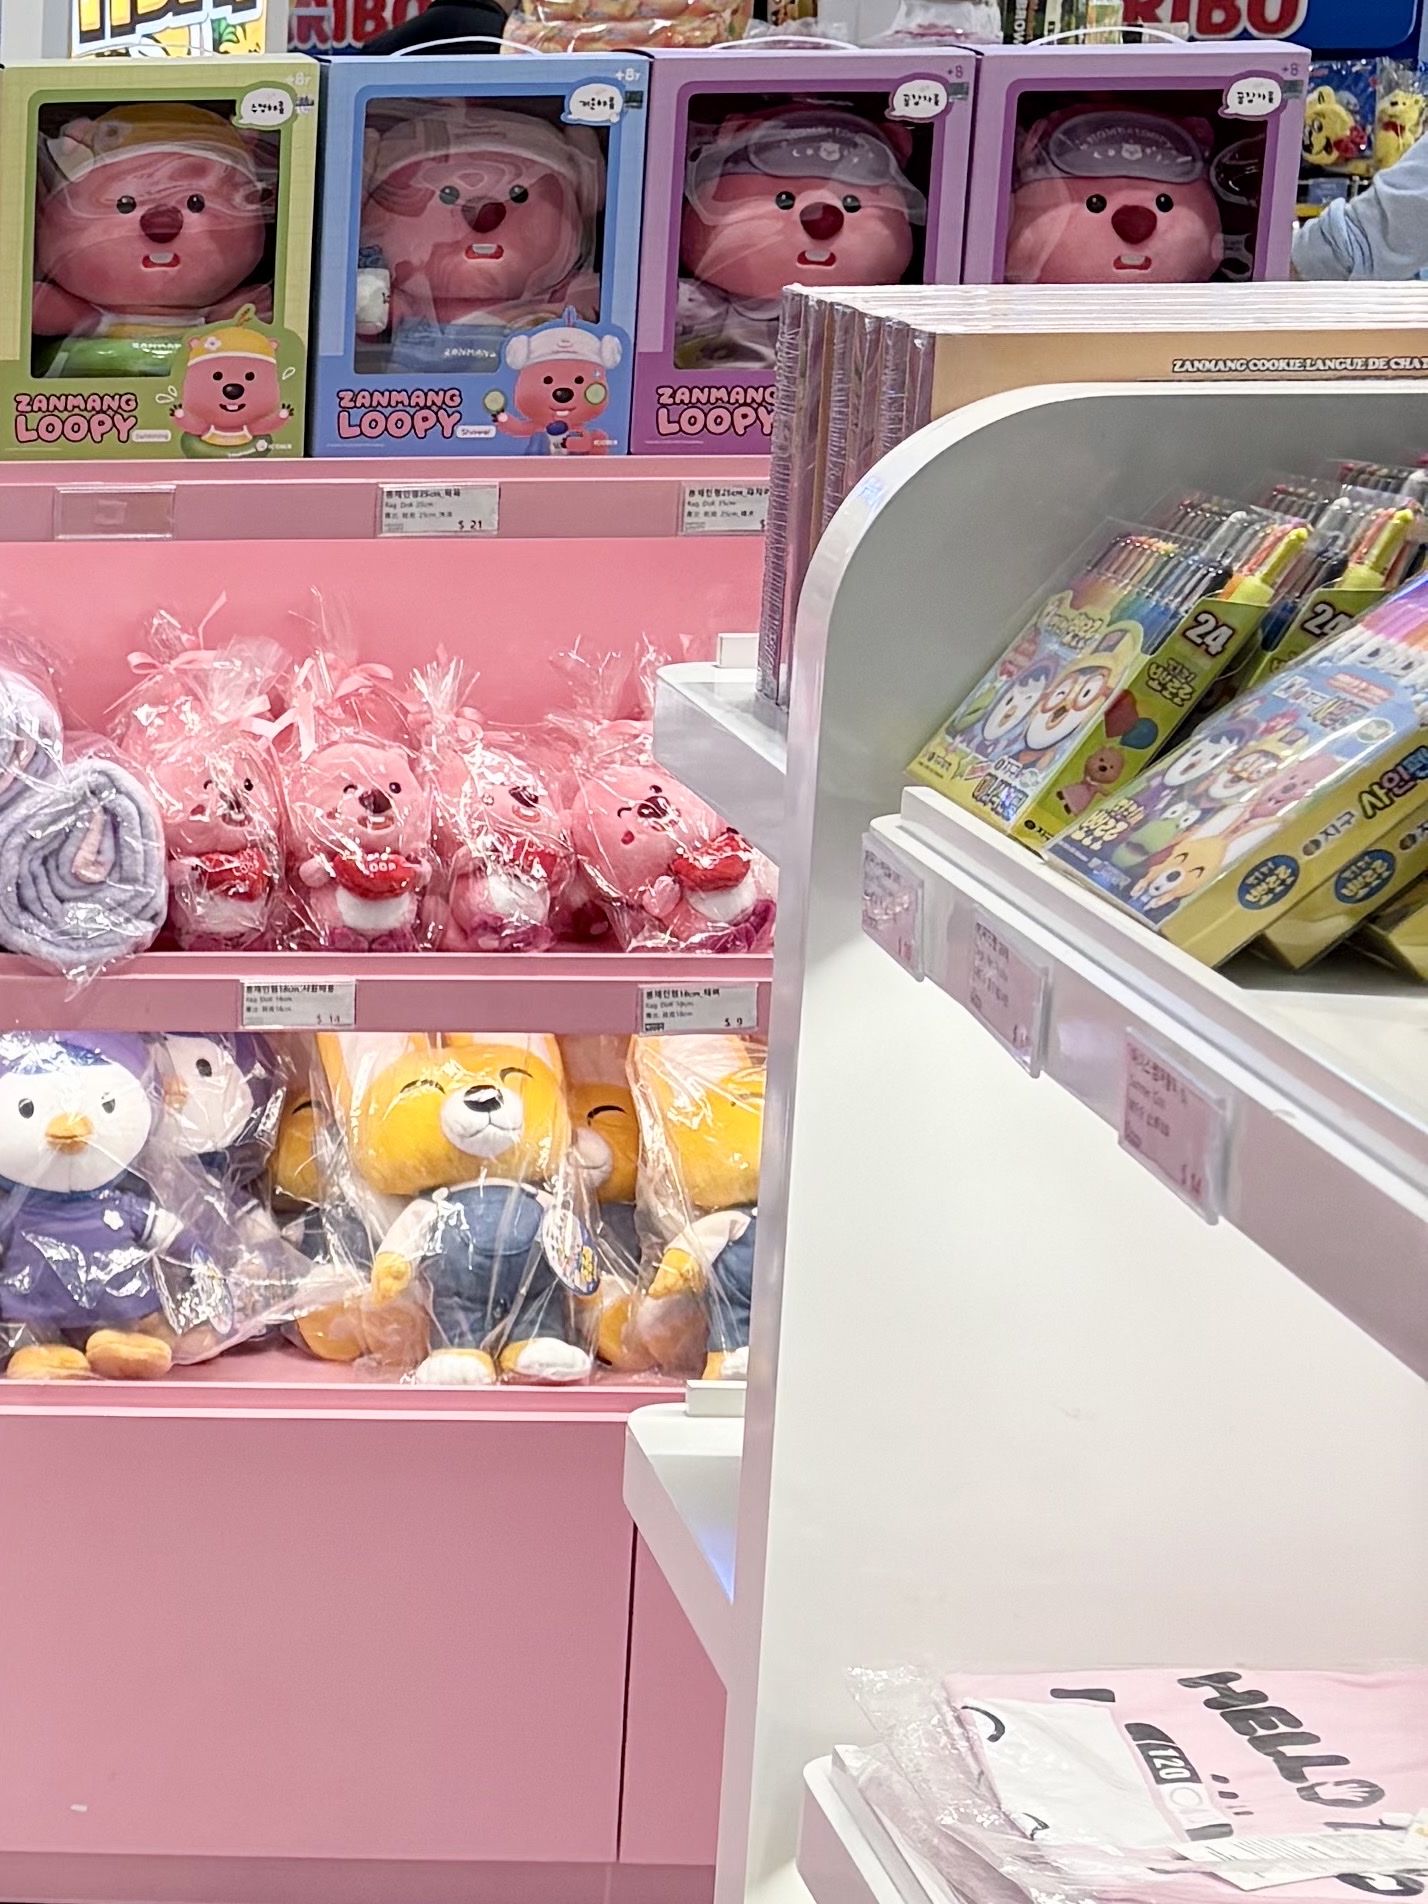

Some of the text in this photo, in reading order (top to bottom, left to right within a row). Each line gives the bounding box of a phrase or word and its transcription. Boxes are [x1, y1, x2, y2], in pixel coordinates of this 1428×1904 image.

[1172, 358, 1387, 373] ZANMANG COOKIE LANGUE DE
[14, 392, 138, 415] ZANMANG
[337, 387, 463, 410] ZANMANG
[15, 412, 138, 445] LOOPY
[338, 409, 463, 440] LOOPY
[657, 405, 775, 438] LOOPY
[469, 519, 483, 530] 21
[1182, 609, 1235, 658] 24
[1300, 599, 1353, 640] 24
[1176, 1670, 1386, 1809] HELLO
[1145, 1746, 1191, 1782] 120
